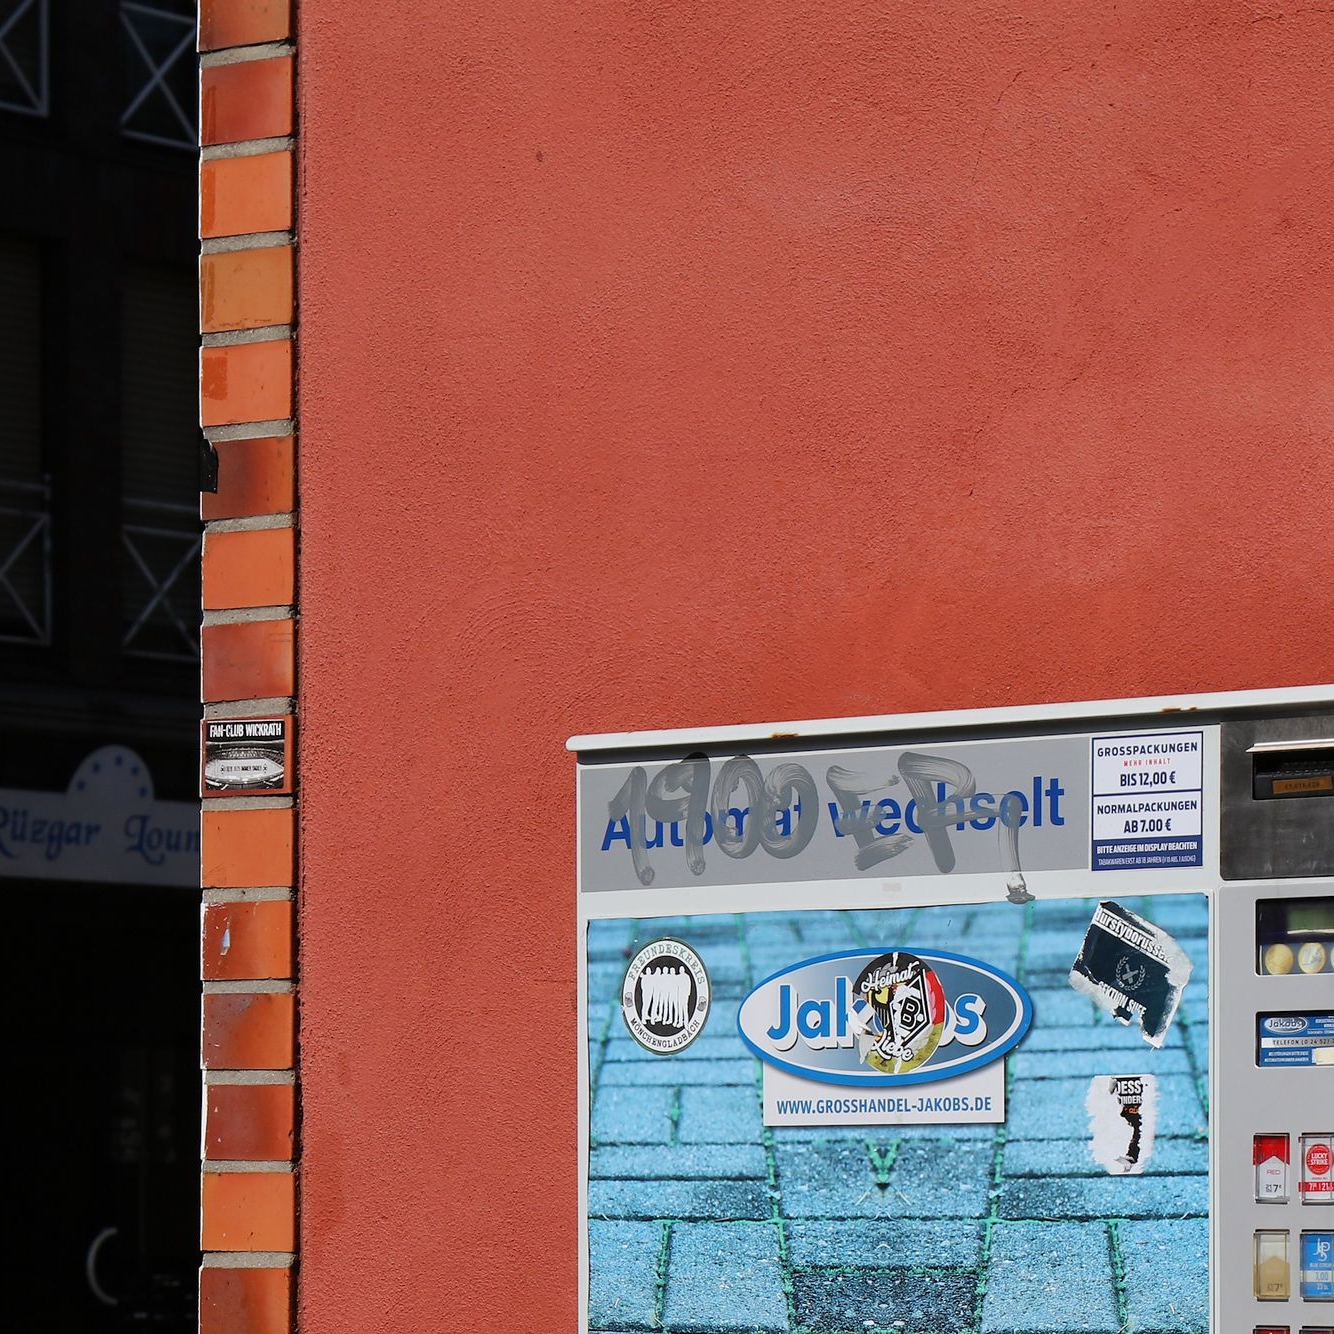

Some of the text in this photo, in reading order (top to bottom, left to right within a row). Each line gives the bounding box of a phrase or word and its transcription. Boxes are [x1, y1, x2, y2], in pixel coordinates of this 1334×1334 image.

[209, 722, 282, 738] FAN-CLUB WICKRATH
[1097, 742, 1198, 758] GROSSPACKUNGEN
[1145, 758, 1171, 766] INHALT
[1120, 771, 1176, 788] BIS 12,00 €
[1097, 800, 1198, 815] NORMALPACKUNGEN
[1123, 818, 1172, 834] AB 7.00 €
[123, 814, 200, 866] Loun
[1097, 841, 1198, 855] BITTE ANZEIGE IM DISPLAY BEACHTEN
[628, 943, 706, 985] FREUNDESKREIS
[860, 960, 920, 993] Heimat
[630, 1017, 701, 1049] MÖNCHENGLADBACH
[871, 1028, 915, 1062] Liebe
[776, 1096, 992, 1116] WWW.GROSSHANDEL-JAKOBS.DE
[1311, 1152, 1328, 1160] LUCKY
